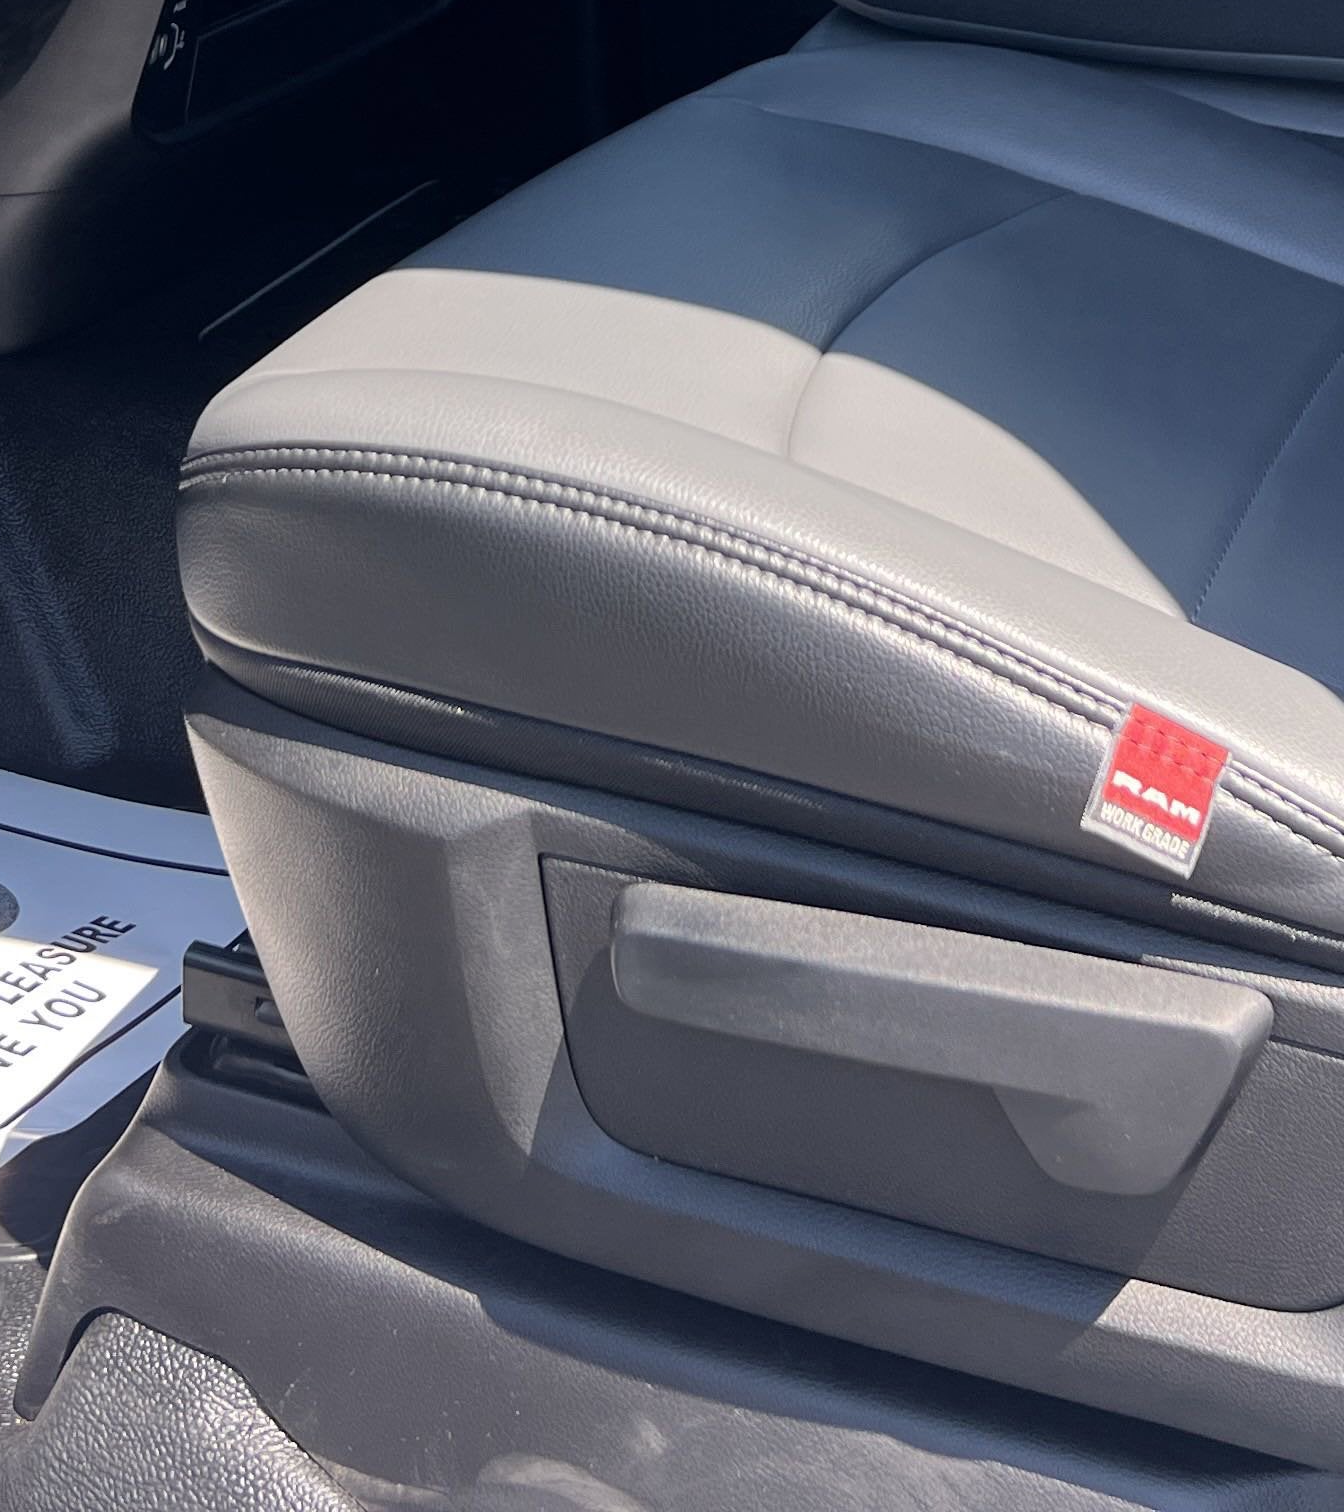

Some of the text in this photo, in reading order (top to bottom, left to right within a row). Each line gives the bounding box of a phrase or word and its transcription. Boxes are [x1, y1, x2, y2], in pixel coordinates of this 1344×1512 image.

[1111, 769, 1202, 826] RAM
[1100, 801, 1191, 860] WORK GRADE
[19, 980, 107, 1031] YOU
